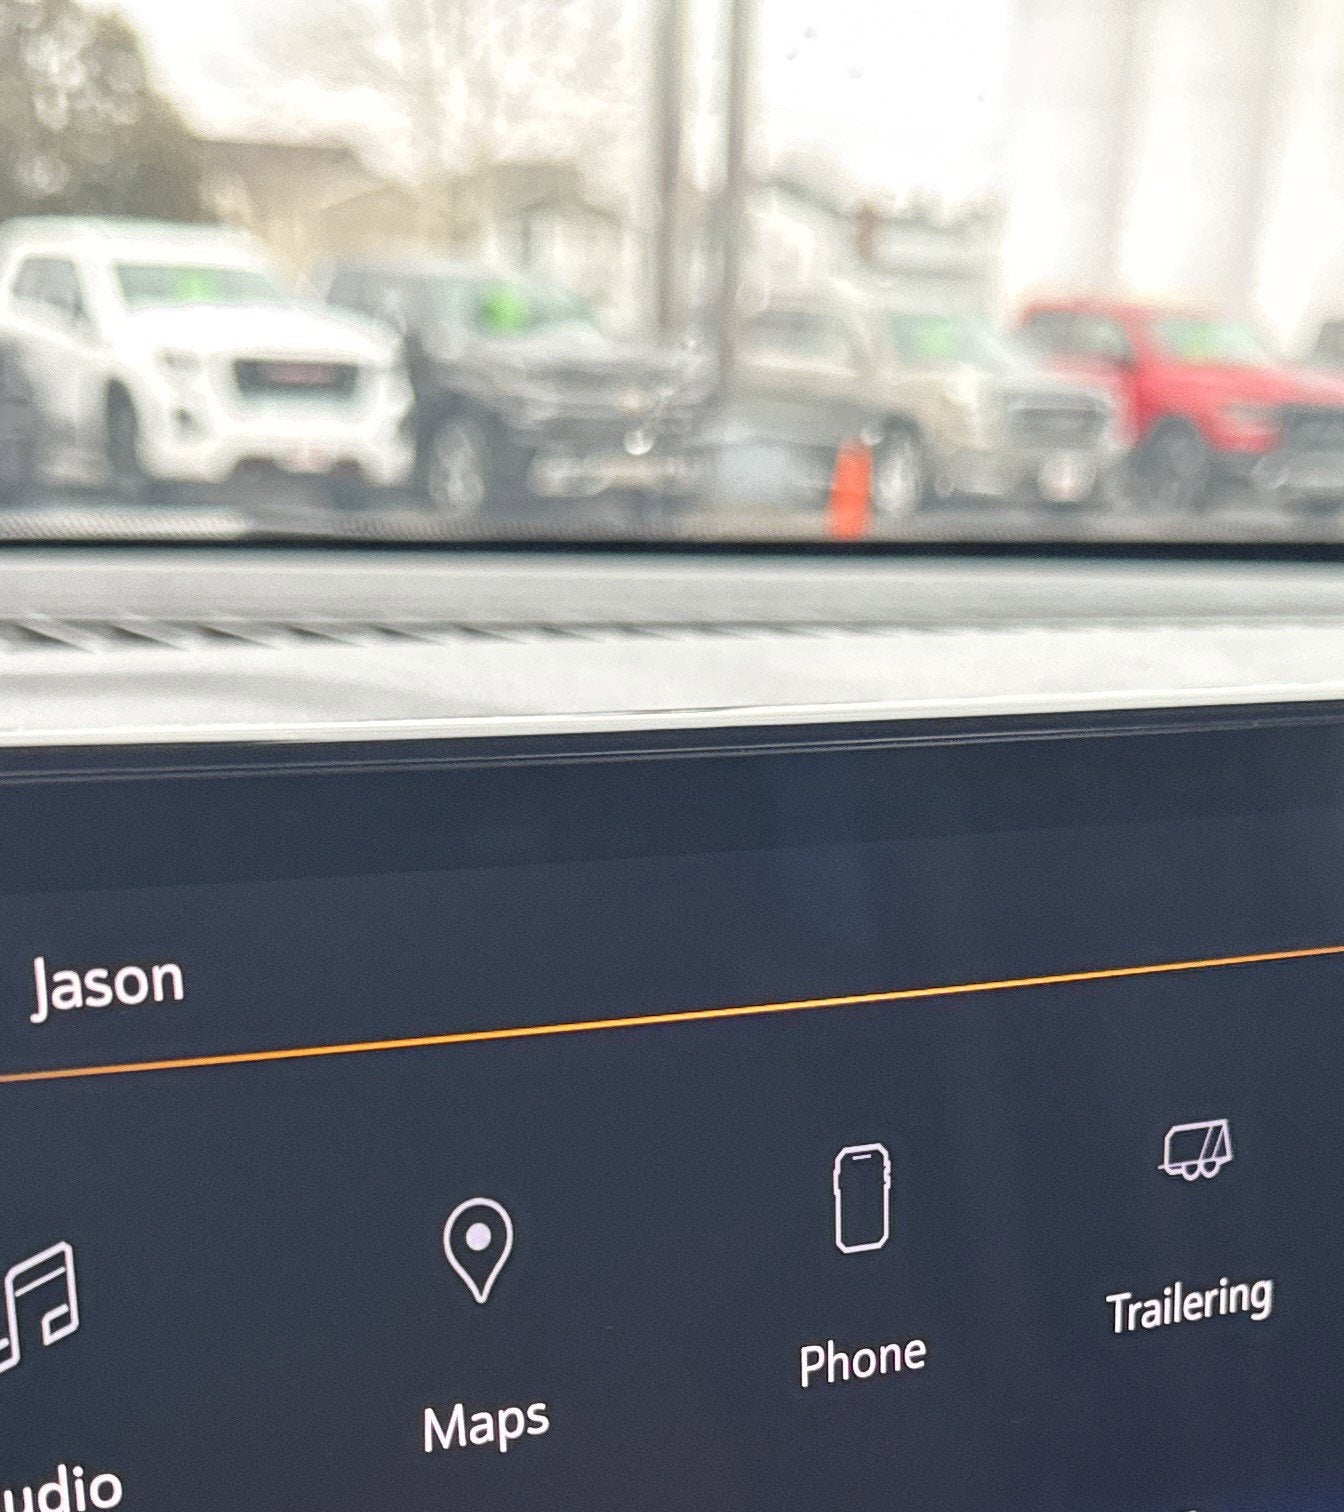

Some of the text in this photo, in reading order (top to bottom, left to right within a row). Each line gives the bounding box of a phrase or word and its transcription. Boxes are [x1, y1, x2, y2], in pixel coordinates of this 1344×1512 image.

[29, 956, 184, 1024] Jason
[1105, 1277, 1273, 1334] Trailering
[800, 1339, 927, 1388] Phone
[424, 1402, 550, 1453] Maps
